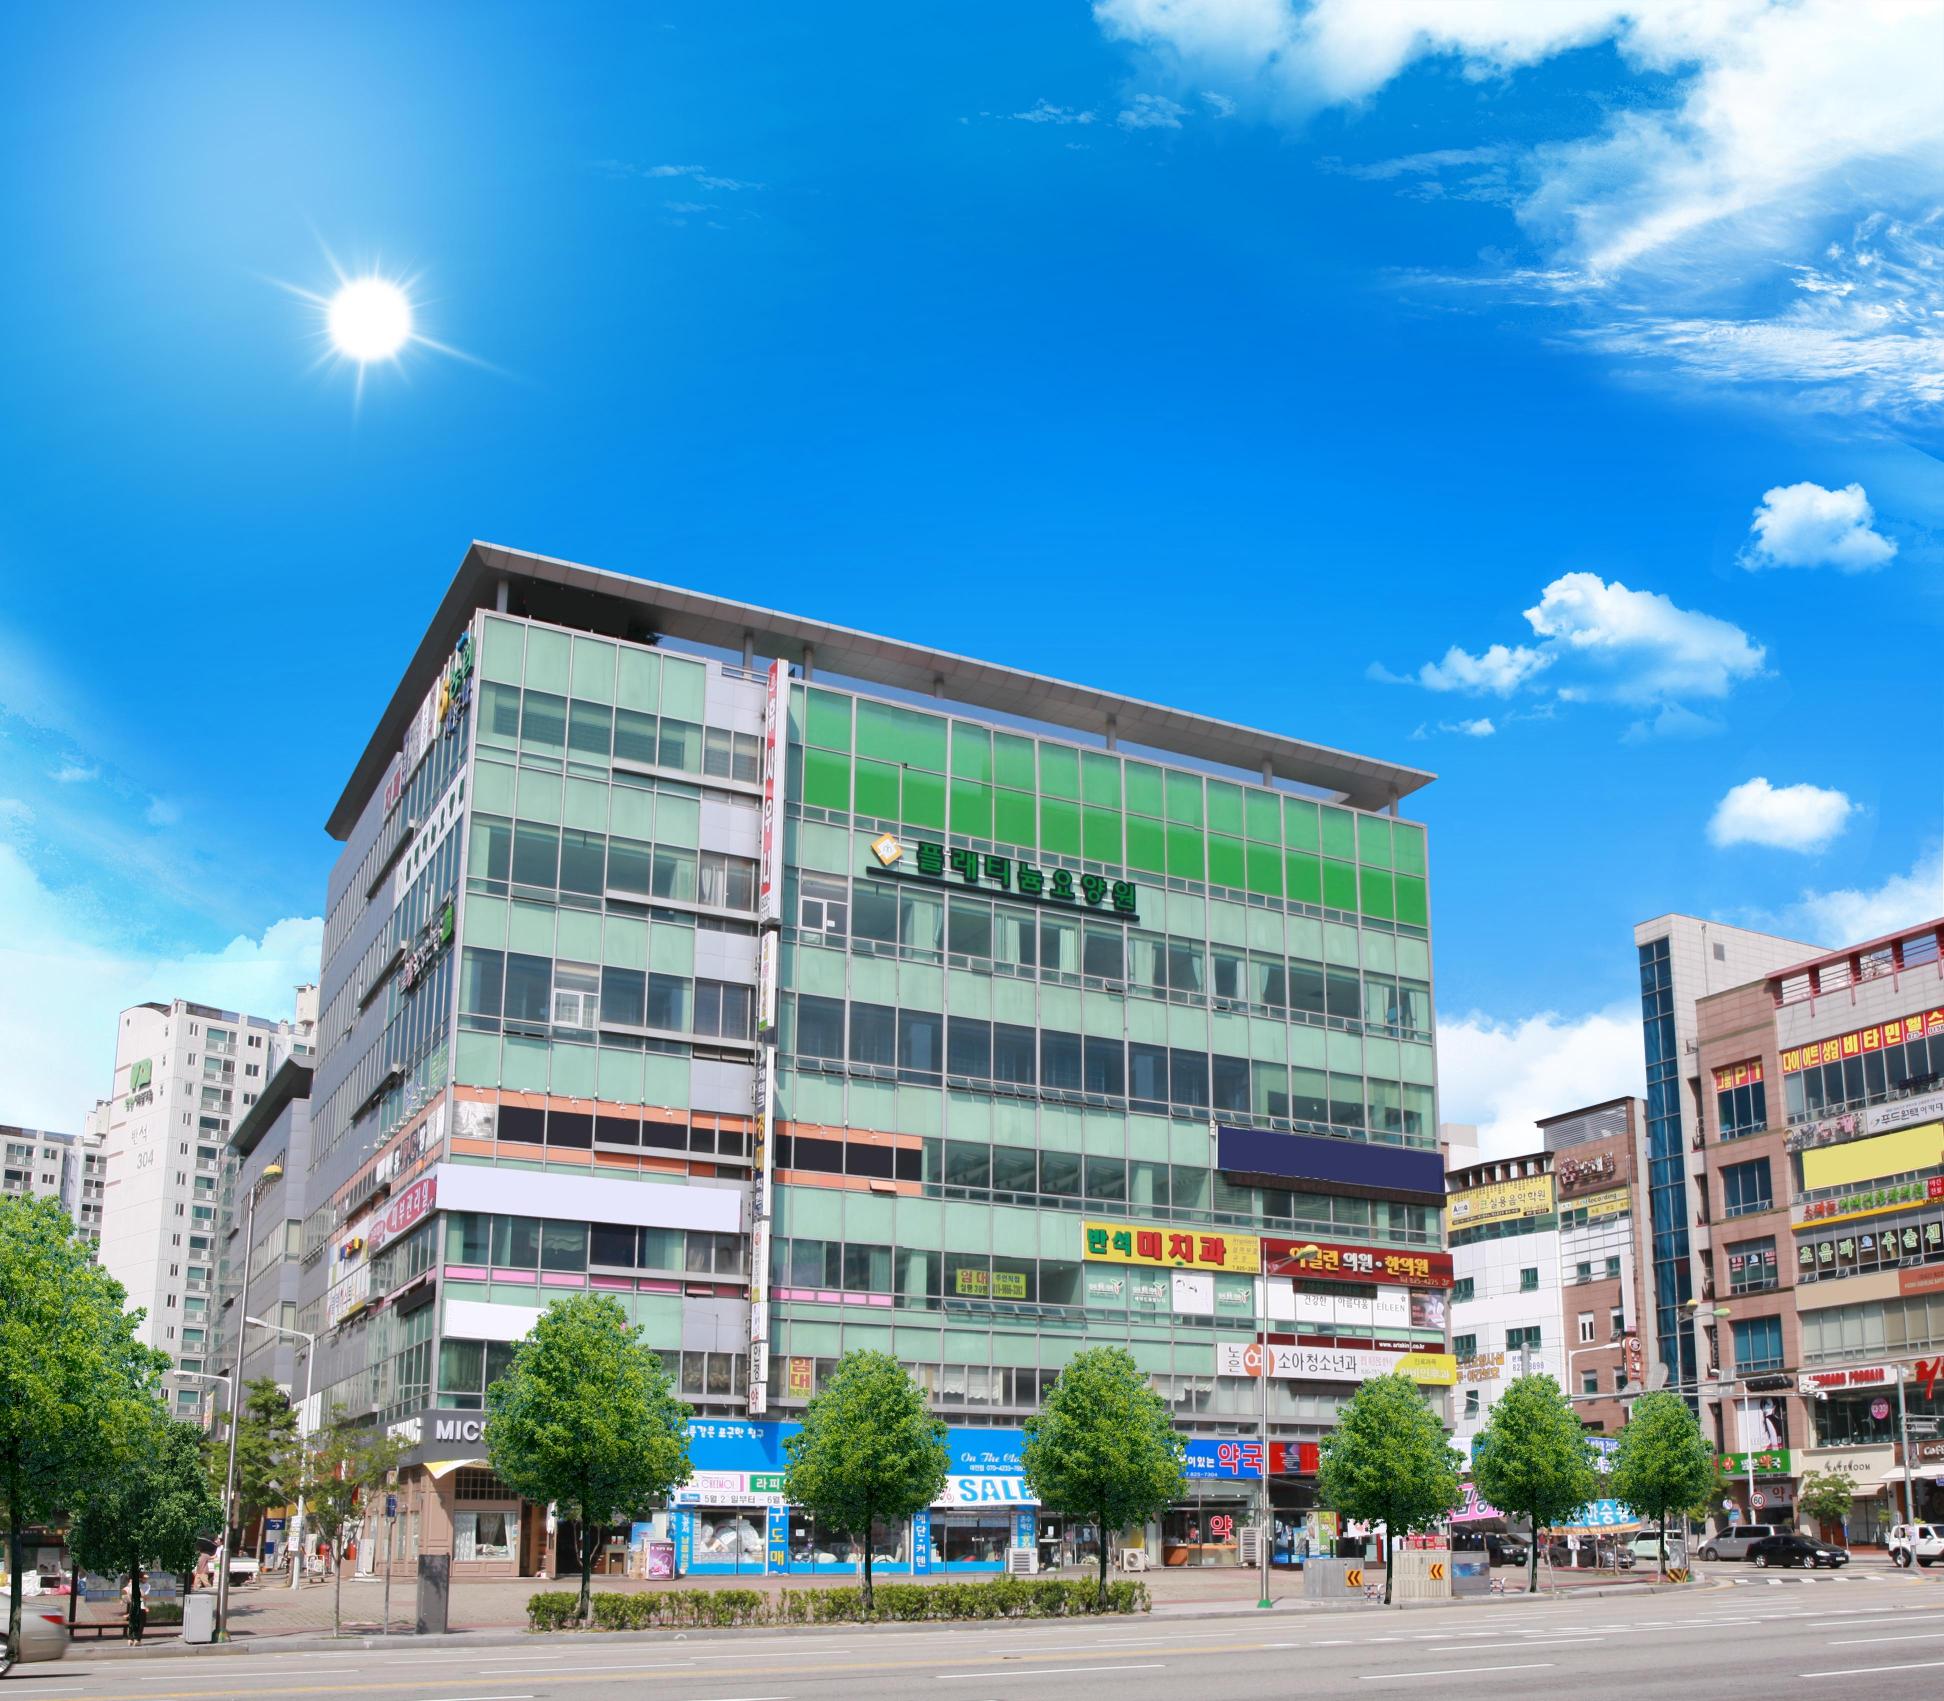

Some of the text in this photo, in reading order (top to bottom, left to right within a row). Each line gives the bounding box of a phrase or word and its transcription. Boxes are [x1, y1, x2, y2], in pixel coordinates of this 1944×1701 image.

[1783, 1045, 1819, 1072] 다이어트
[137, 1149, 153, 1169] 304
[1343, 1253, 1373, 1272] 의원
[1385, 1256, 1429, 1277] 한의원
[790, 1358, 812, 1389] 임대
[1278, 1352, 1358, 1374] 소아청소년과
[961, 1452, 976, 1463] On
[981, 1452, 1000, 1463] The
[1218, 1443, 1264, 1475] 약국
[958, 1478, 1034, 1502] SALE
[1753, 1495, 1763, 1505] 60
[1210, 1515, 1233, 1542] 약
